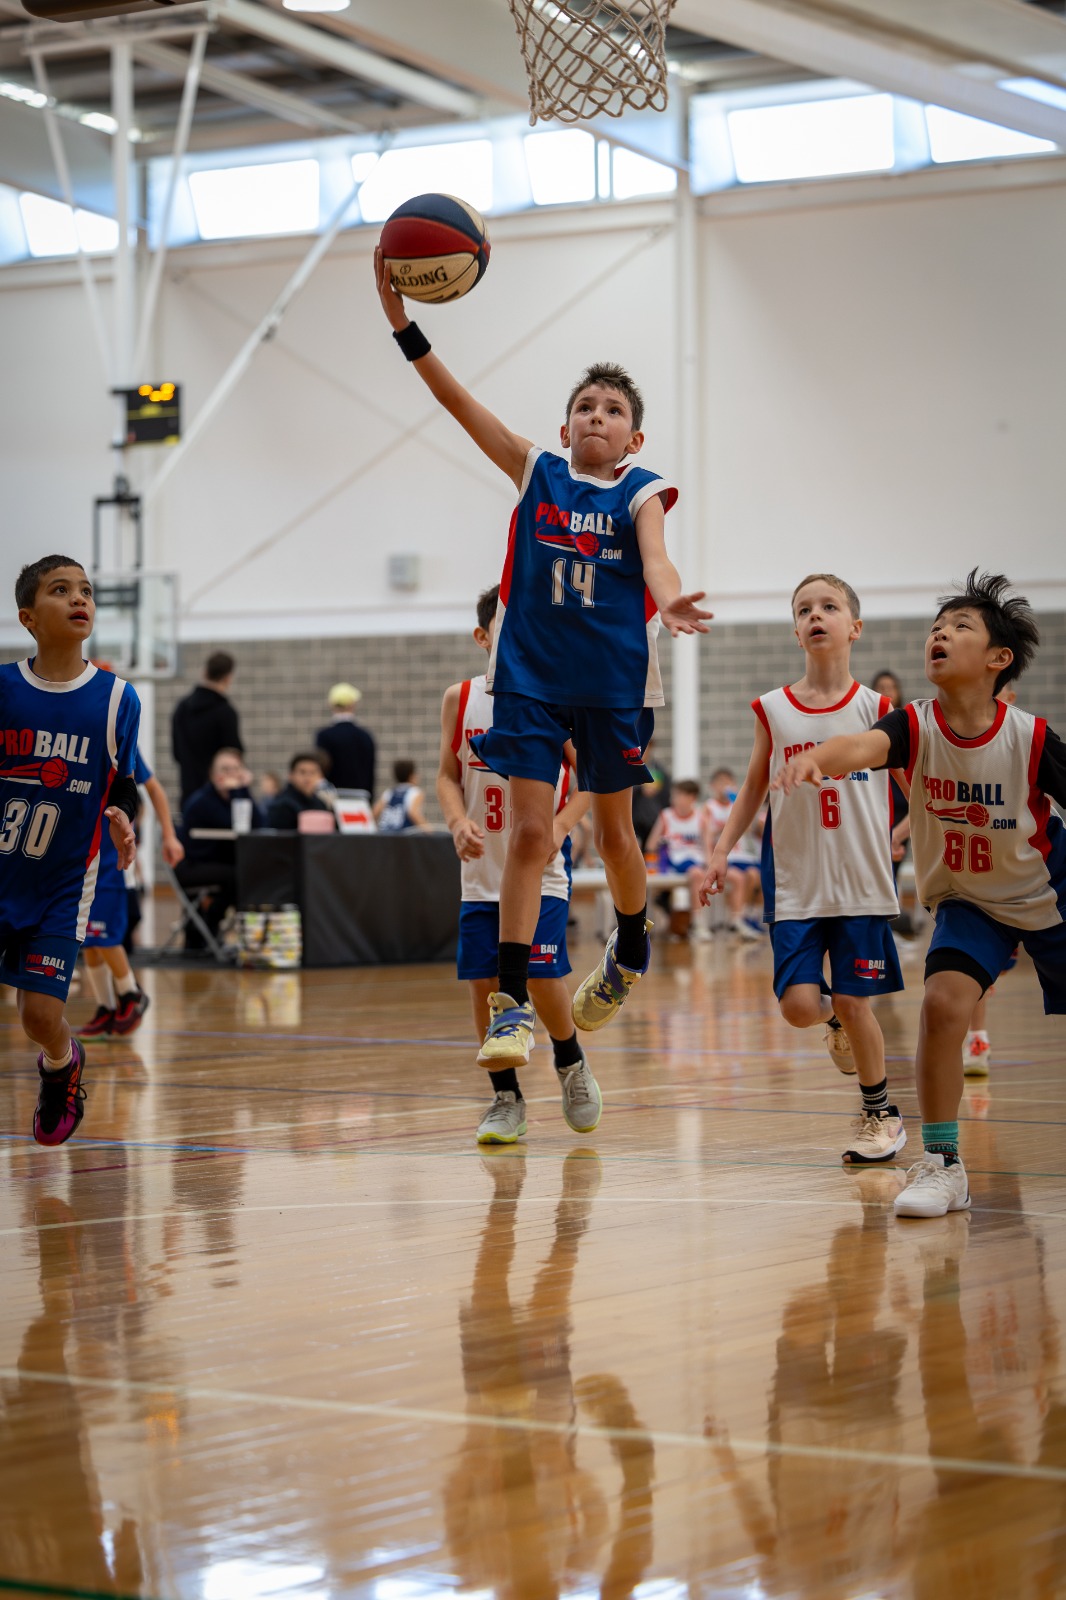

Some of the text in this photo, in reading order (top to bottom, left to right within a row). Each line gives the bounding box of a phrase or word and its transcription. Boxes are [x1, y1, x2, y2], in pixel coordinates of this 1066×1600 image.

[535, 501, 615, 537] PROBALL
[599, 548, 623, 560] .COM
[552, 557, 596, 608] 14
[66, 779, 92, 795] .COM
[849, 771, 869, 782] .COM
[484, 785, 513, 833] 3
[818, 787, 842, 830] 6
[990, 818, 1017, 830] .COM
[0, 797, 61, 860] 30
[942, 829, 993, 875] 66
